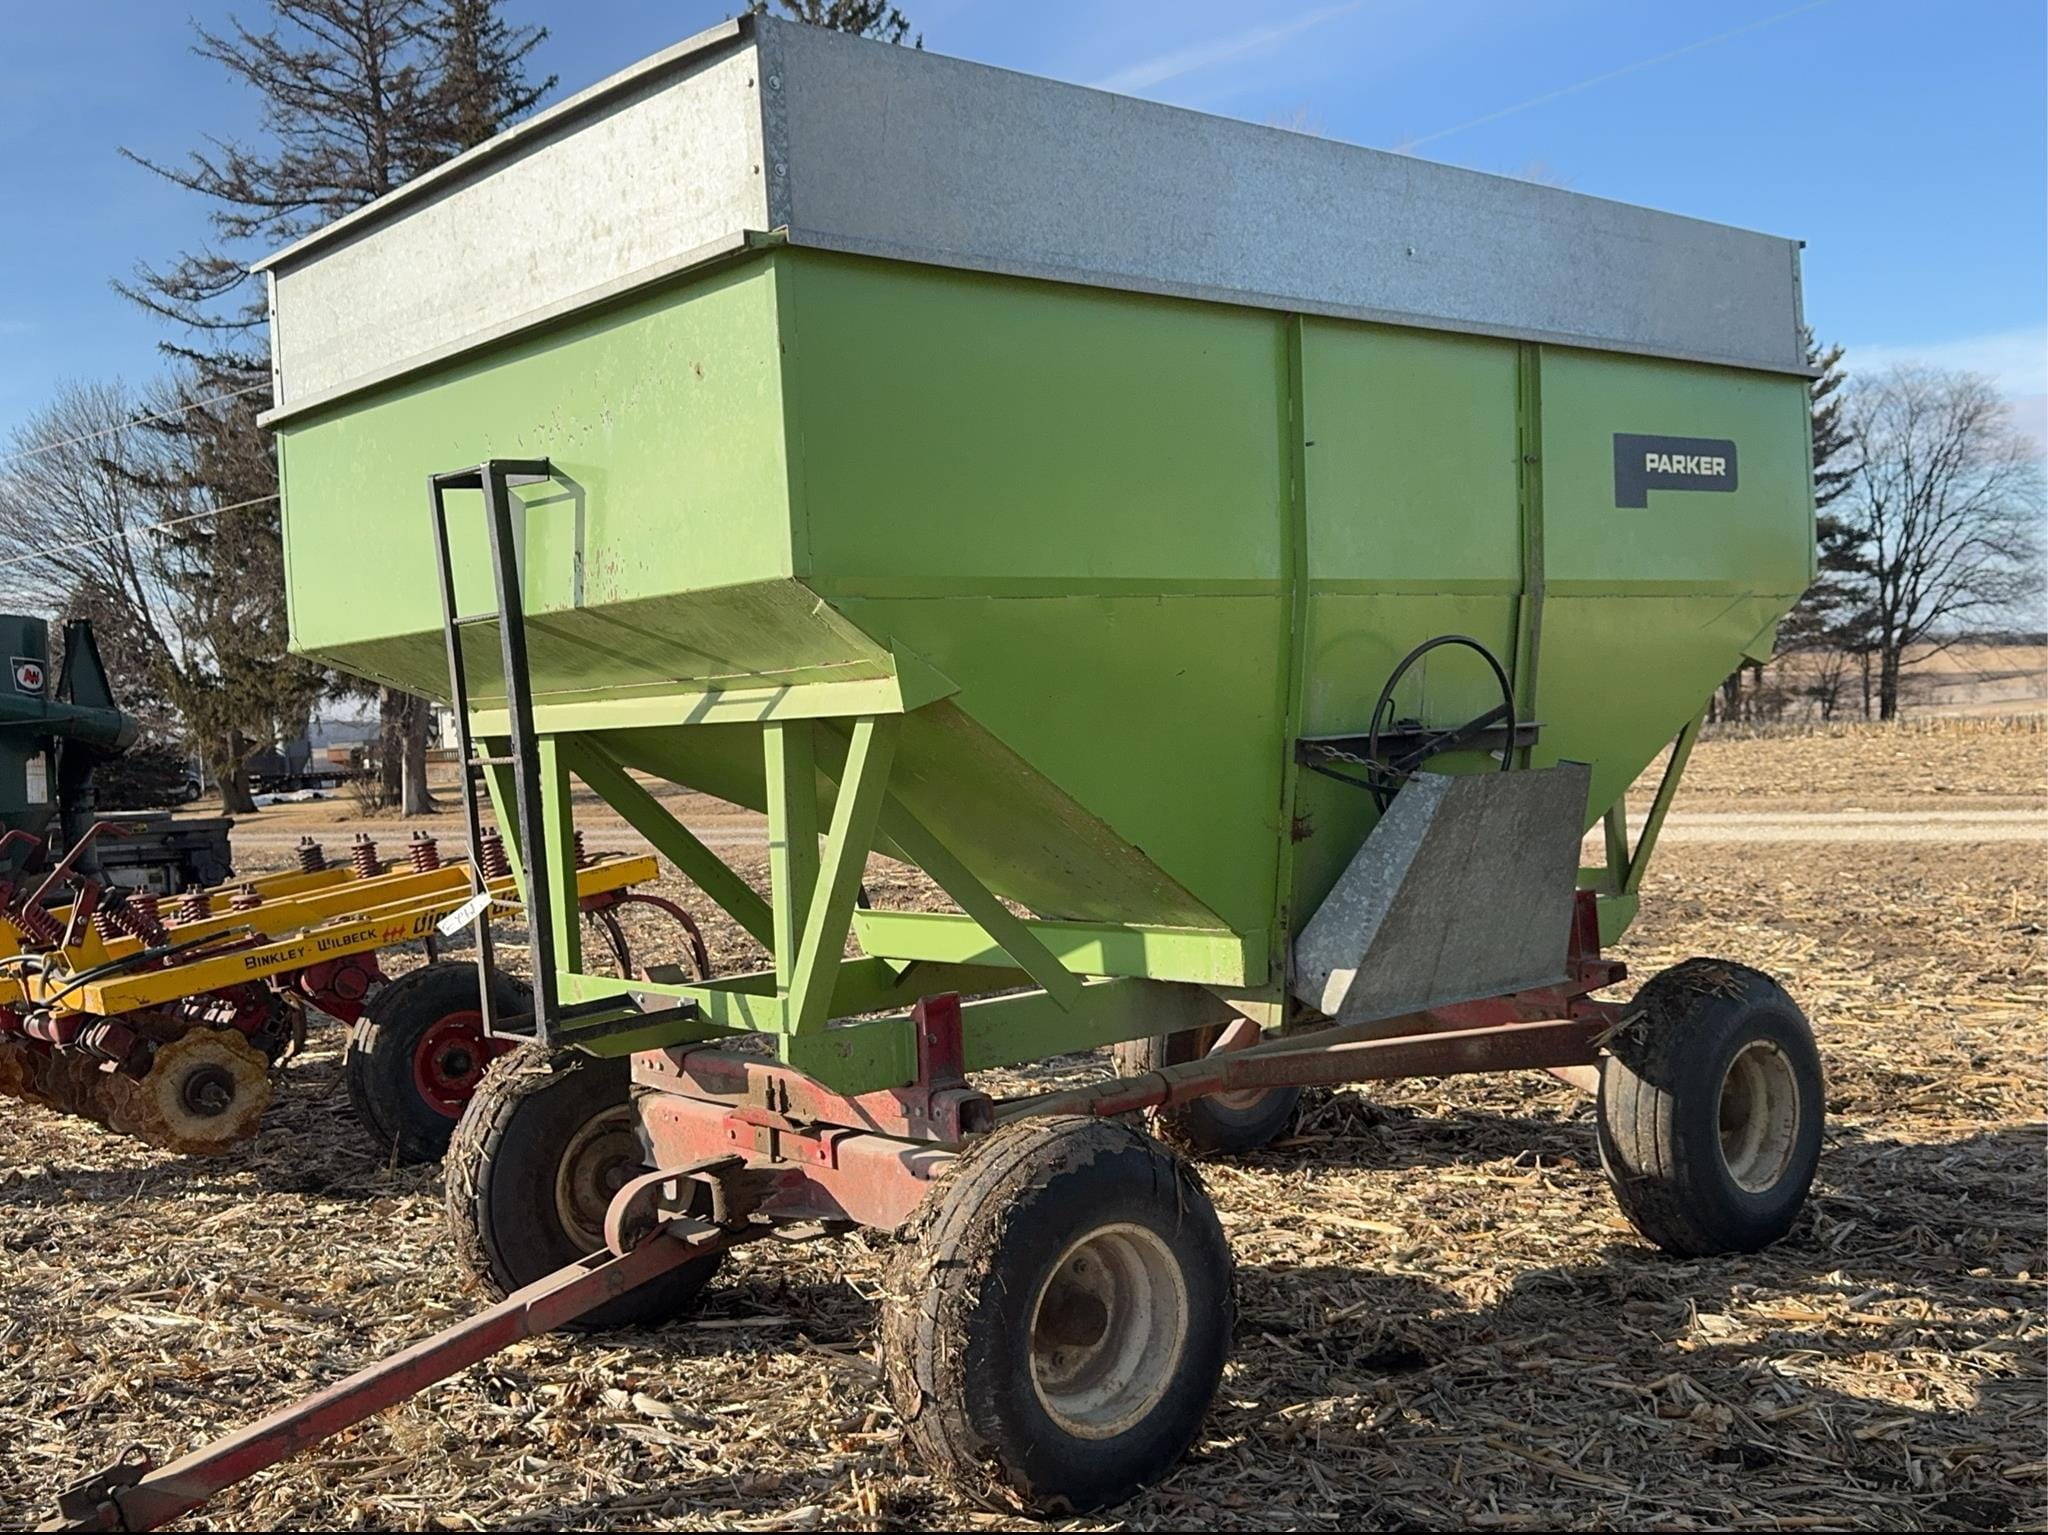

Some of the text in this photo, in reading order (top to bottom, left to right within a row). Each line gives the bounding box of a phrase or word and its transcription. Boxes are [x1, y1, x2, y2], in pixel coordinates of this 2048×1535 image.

[1645, 453, 1726, 476] PARKER
[244, 947, 305, 969] BINKLEY
[317, 928, 378, 952] WILBECK
